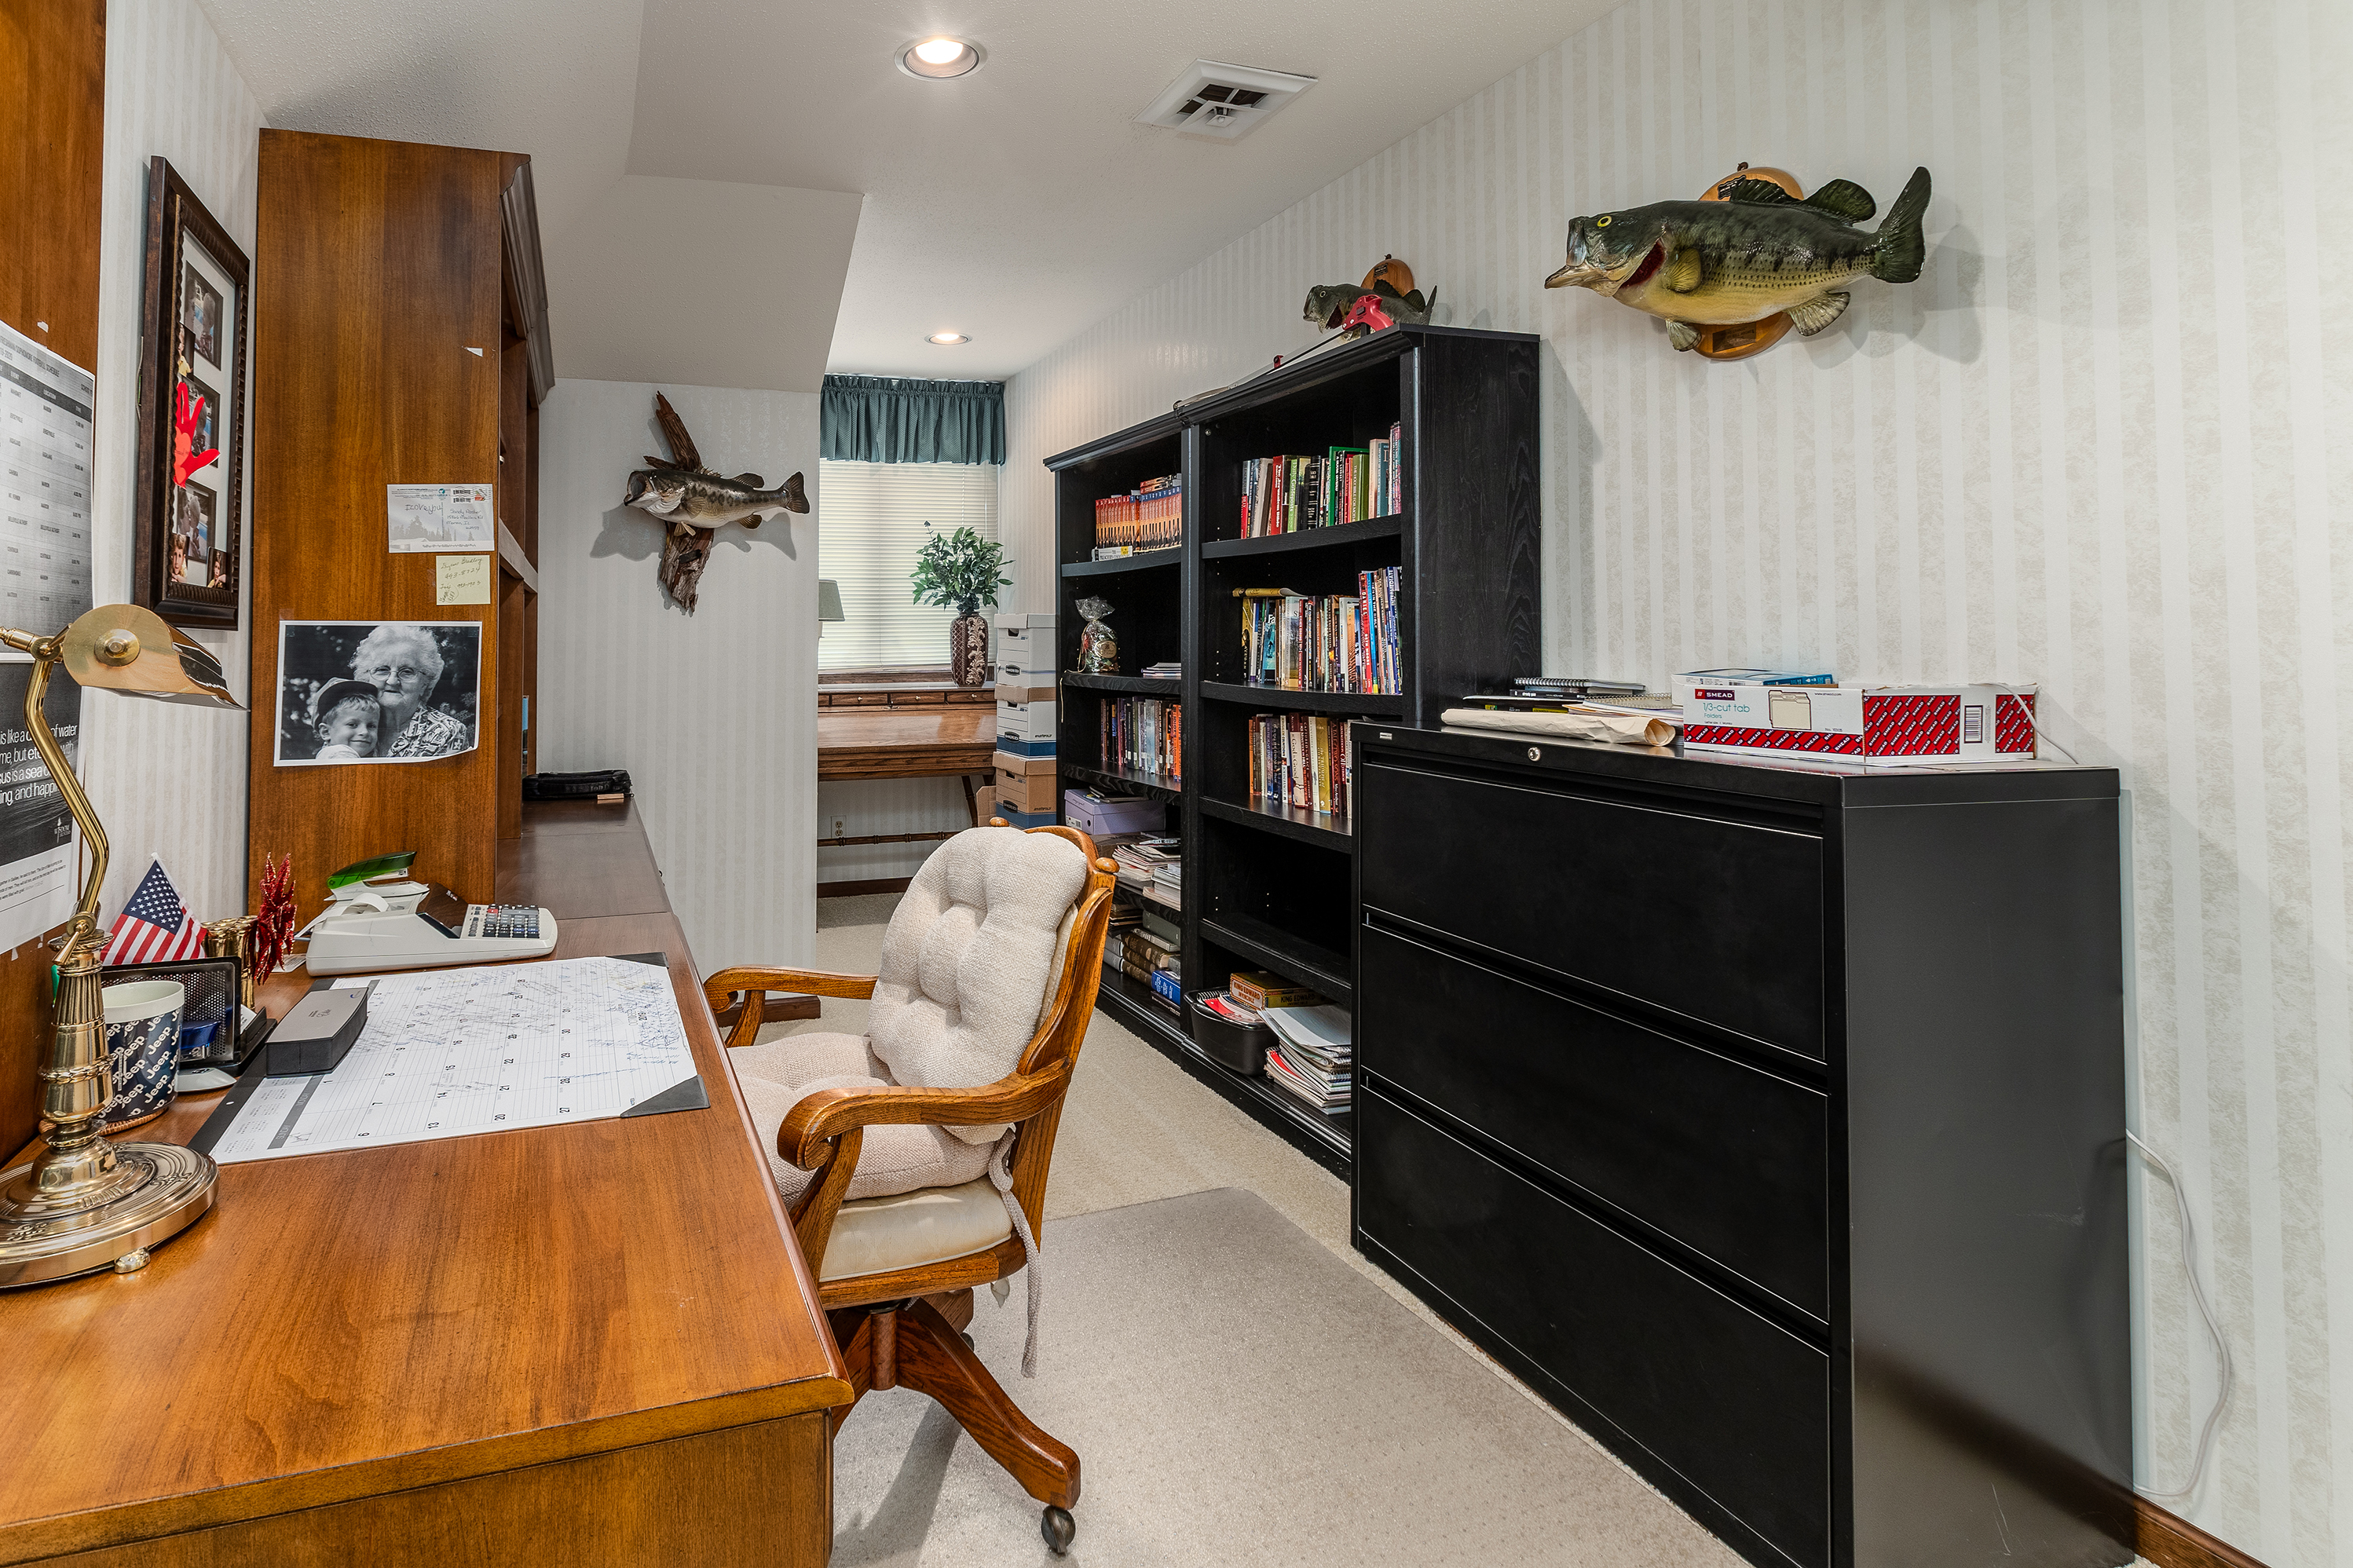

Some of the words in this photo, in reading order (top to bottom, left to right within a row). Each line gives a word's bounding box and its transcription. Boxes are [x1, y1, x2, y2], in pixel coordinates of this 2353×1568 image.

[1703, 702, 1731, 712] 1/3-cut
[1734, 704, 1751, 713] tab
[1868, 702, 1880, 717] SMEAD
[1890, 702, 1902, 716] SMEAD
[1912, 701, 1923, 716] SMEAD
[1934, 701, 1945, 715] SMEAD
[1996, 700, 2007, 714] SMEAD
[1876, 711, 1887, 726] SMEAD
[1897, 711, 1909, 726] SMEAD
[1919, 711, 1930, 726] SMEAD
[1941, 711, 1952, 725] SMEAD
[2004, 710, 2014, 724] SMEAD
[1883, 722, 1894, 736] SMEAD
[1905, 721, 1916, 736] SMEAD
[1927, 721, 1938, 735] SMEAD
[1948, 720, 1959, 734] SMEAD
[2010, 719, 2021, 733] SMEAD
[8, 729, 20, 744] like
[20, 732, 24, 742] a
[58, 725, 77, 737] water
[1696, 728, 1708, 740] SMEAD
[1721, 729, 1734, 742] SMEAD
[1747, 731, 1762, 744] SMEAD
[1775, 733, 1789, 747] SMEAD
[1805, 735, 1819, 748] SMEAD
[1868, 731, 1880, 746] SMEAD
[1890, 731, 1902, 745] SMEAD
[1912, 730, 1923, 745] SMEAD
[1934, 730, 1945, 744] SMEAD
[1996, 729, 2007, 743] SMEAD
[2017, 729, 2027, 742] SMEAD
[1835, 736, 1850, 751] SMEAD
[1876, 740, 1887, 755] SMEAD
[1898, 740, 1909, 755] SMEAD
[1919, 740, 1930, 755] SMEAD
[1941, 740, 1952, 754] SMEAD
[2004, 738, 2014, 752] SMEAD
[14, 747, 27, 762] but
[12, 769, 17, 781] is
[19, 769, 24, 780] a
[26, 766, 42, 779] sea
[15, 784, 32, 800] and
[1234, 982, 1243, 992] KING
[1243, 985, 1261, 1000] EDWARD
[106, 1023, 121, 1041] eep
[148, 1026, 170, 1054] Jeep
[147, 1051, 170, 1080] Jeep
[145, 1075, 168, 1103] Jeep
[98, 1094, 123, 1118] Jeep
